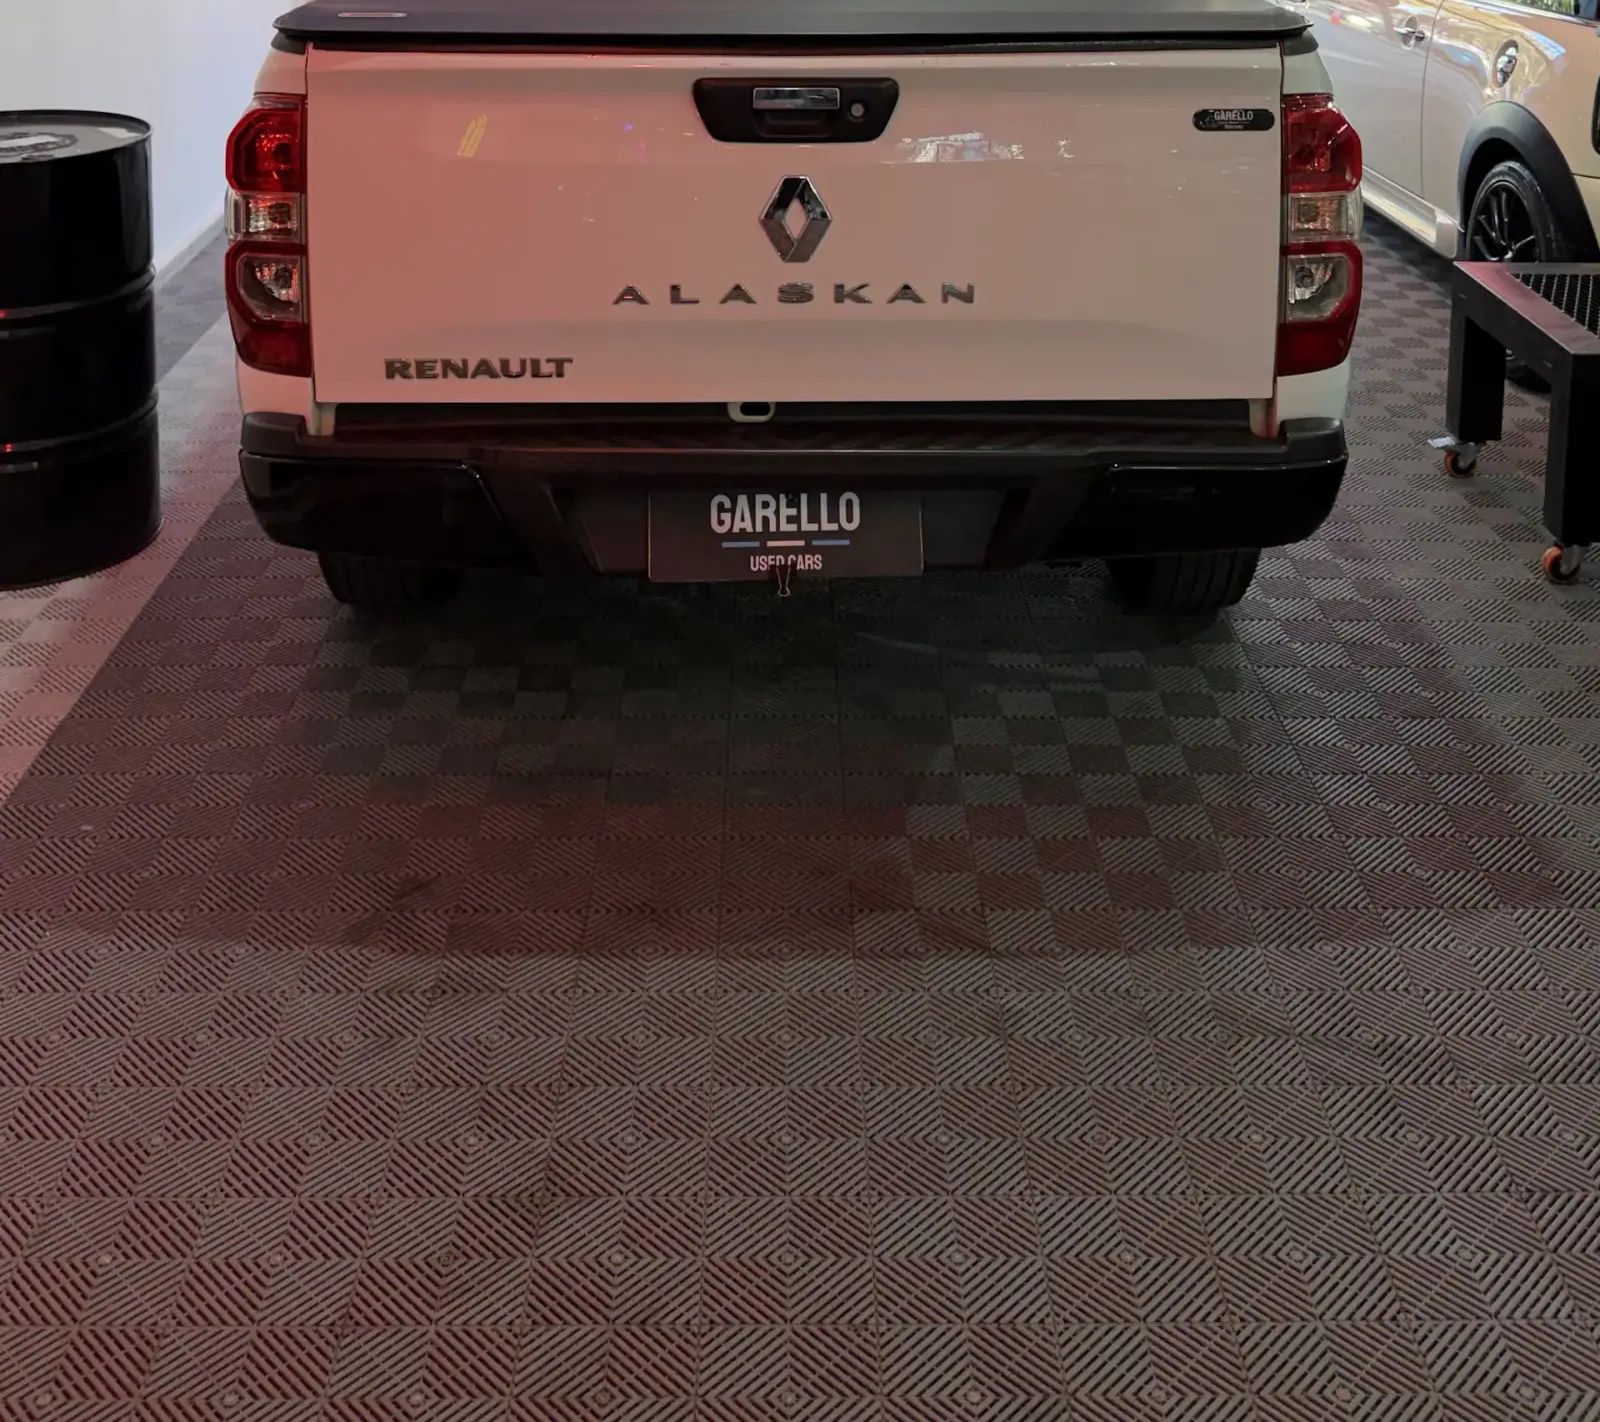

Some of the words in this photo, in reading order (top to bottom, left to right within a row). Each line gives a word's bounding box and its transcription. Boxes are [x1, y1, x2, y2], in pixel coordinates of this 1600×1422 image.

[1214, 110, 1254, 121] GARELLO
[611, 283, 976, 306] ALASKAN
[384, 357, 573, 380] RENAULT
[710, 492, 861, 534] GARELLO
